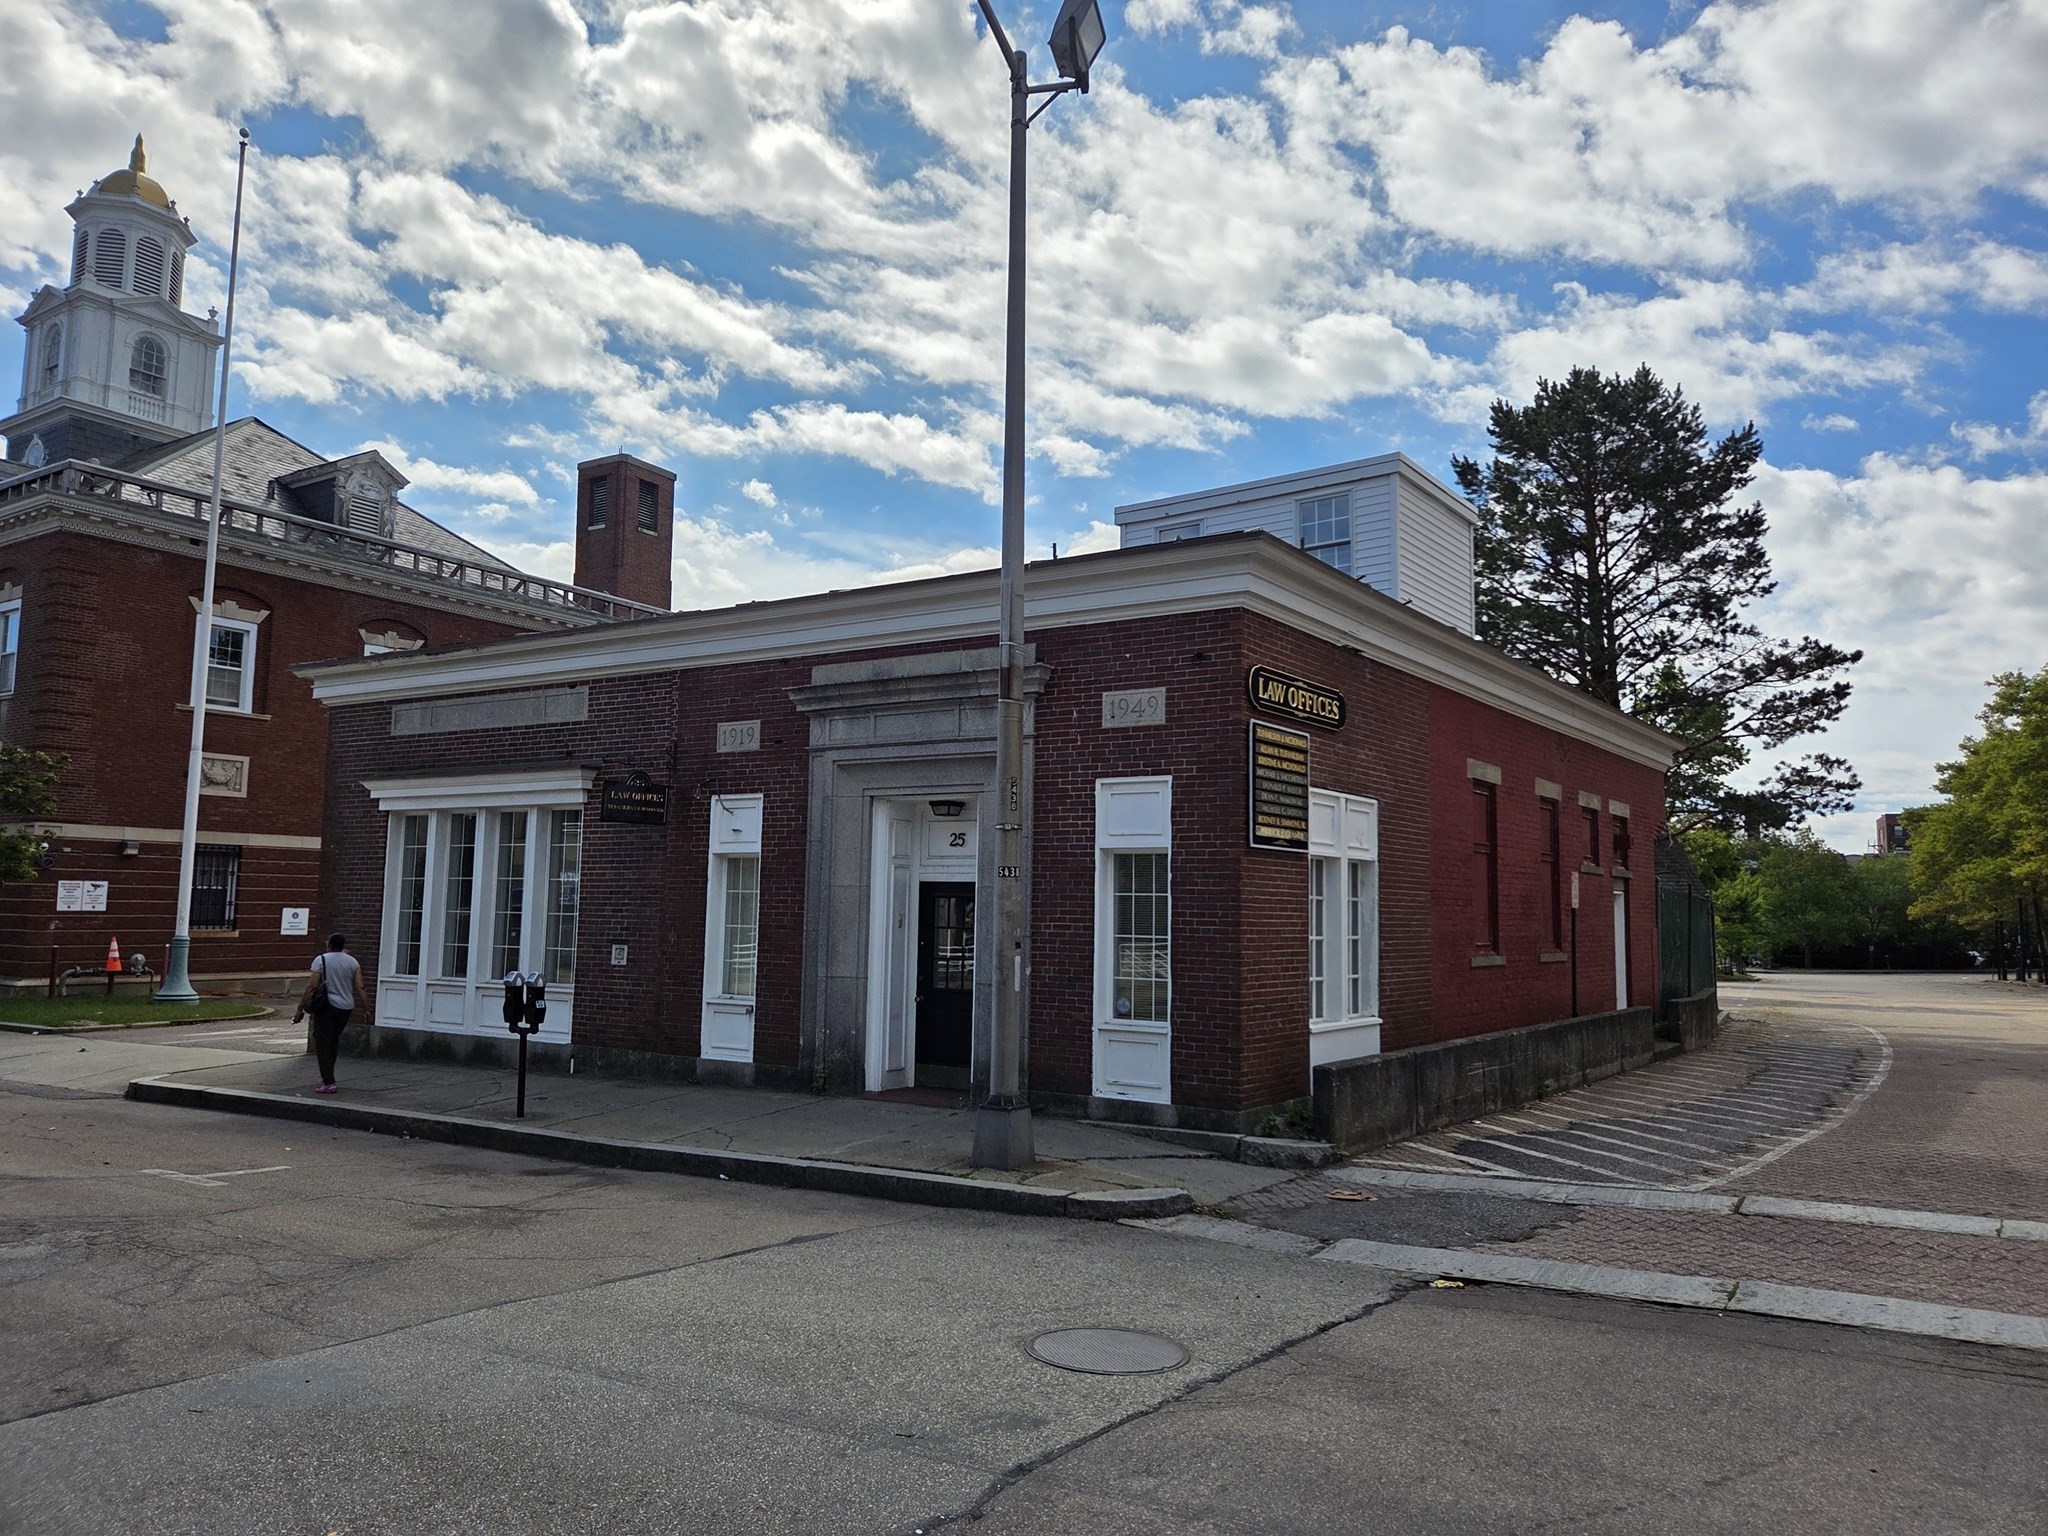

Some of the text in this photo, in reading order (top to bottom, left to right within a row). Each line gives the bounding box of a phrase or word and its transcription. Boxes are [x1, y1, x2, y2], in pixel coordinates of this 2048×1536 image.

[1258, 677, 1340, 719] LAW OFFICES
[1110, 696, 1158, 719] 1949
[722, 726, 755, 746] 1919
[611, 790, 664, 802] LAW OFFICES
[949, 832, 966, 847] 25
[998, 866, 1020, 878] 5438
